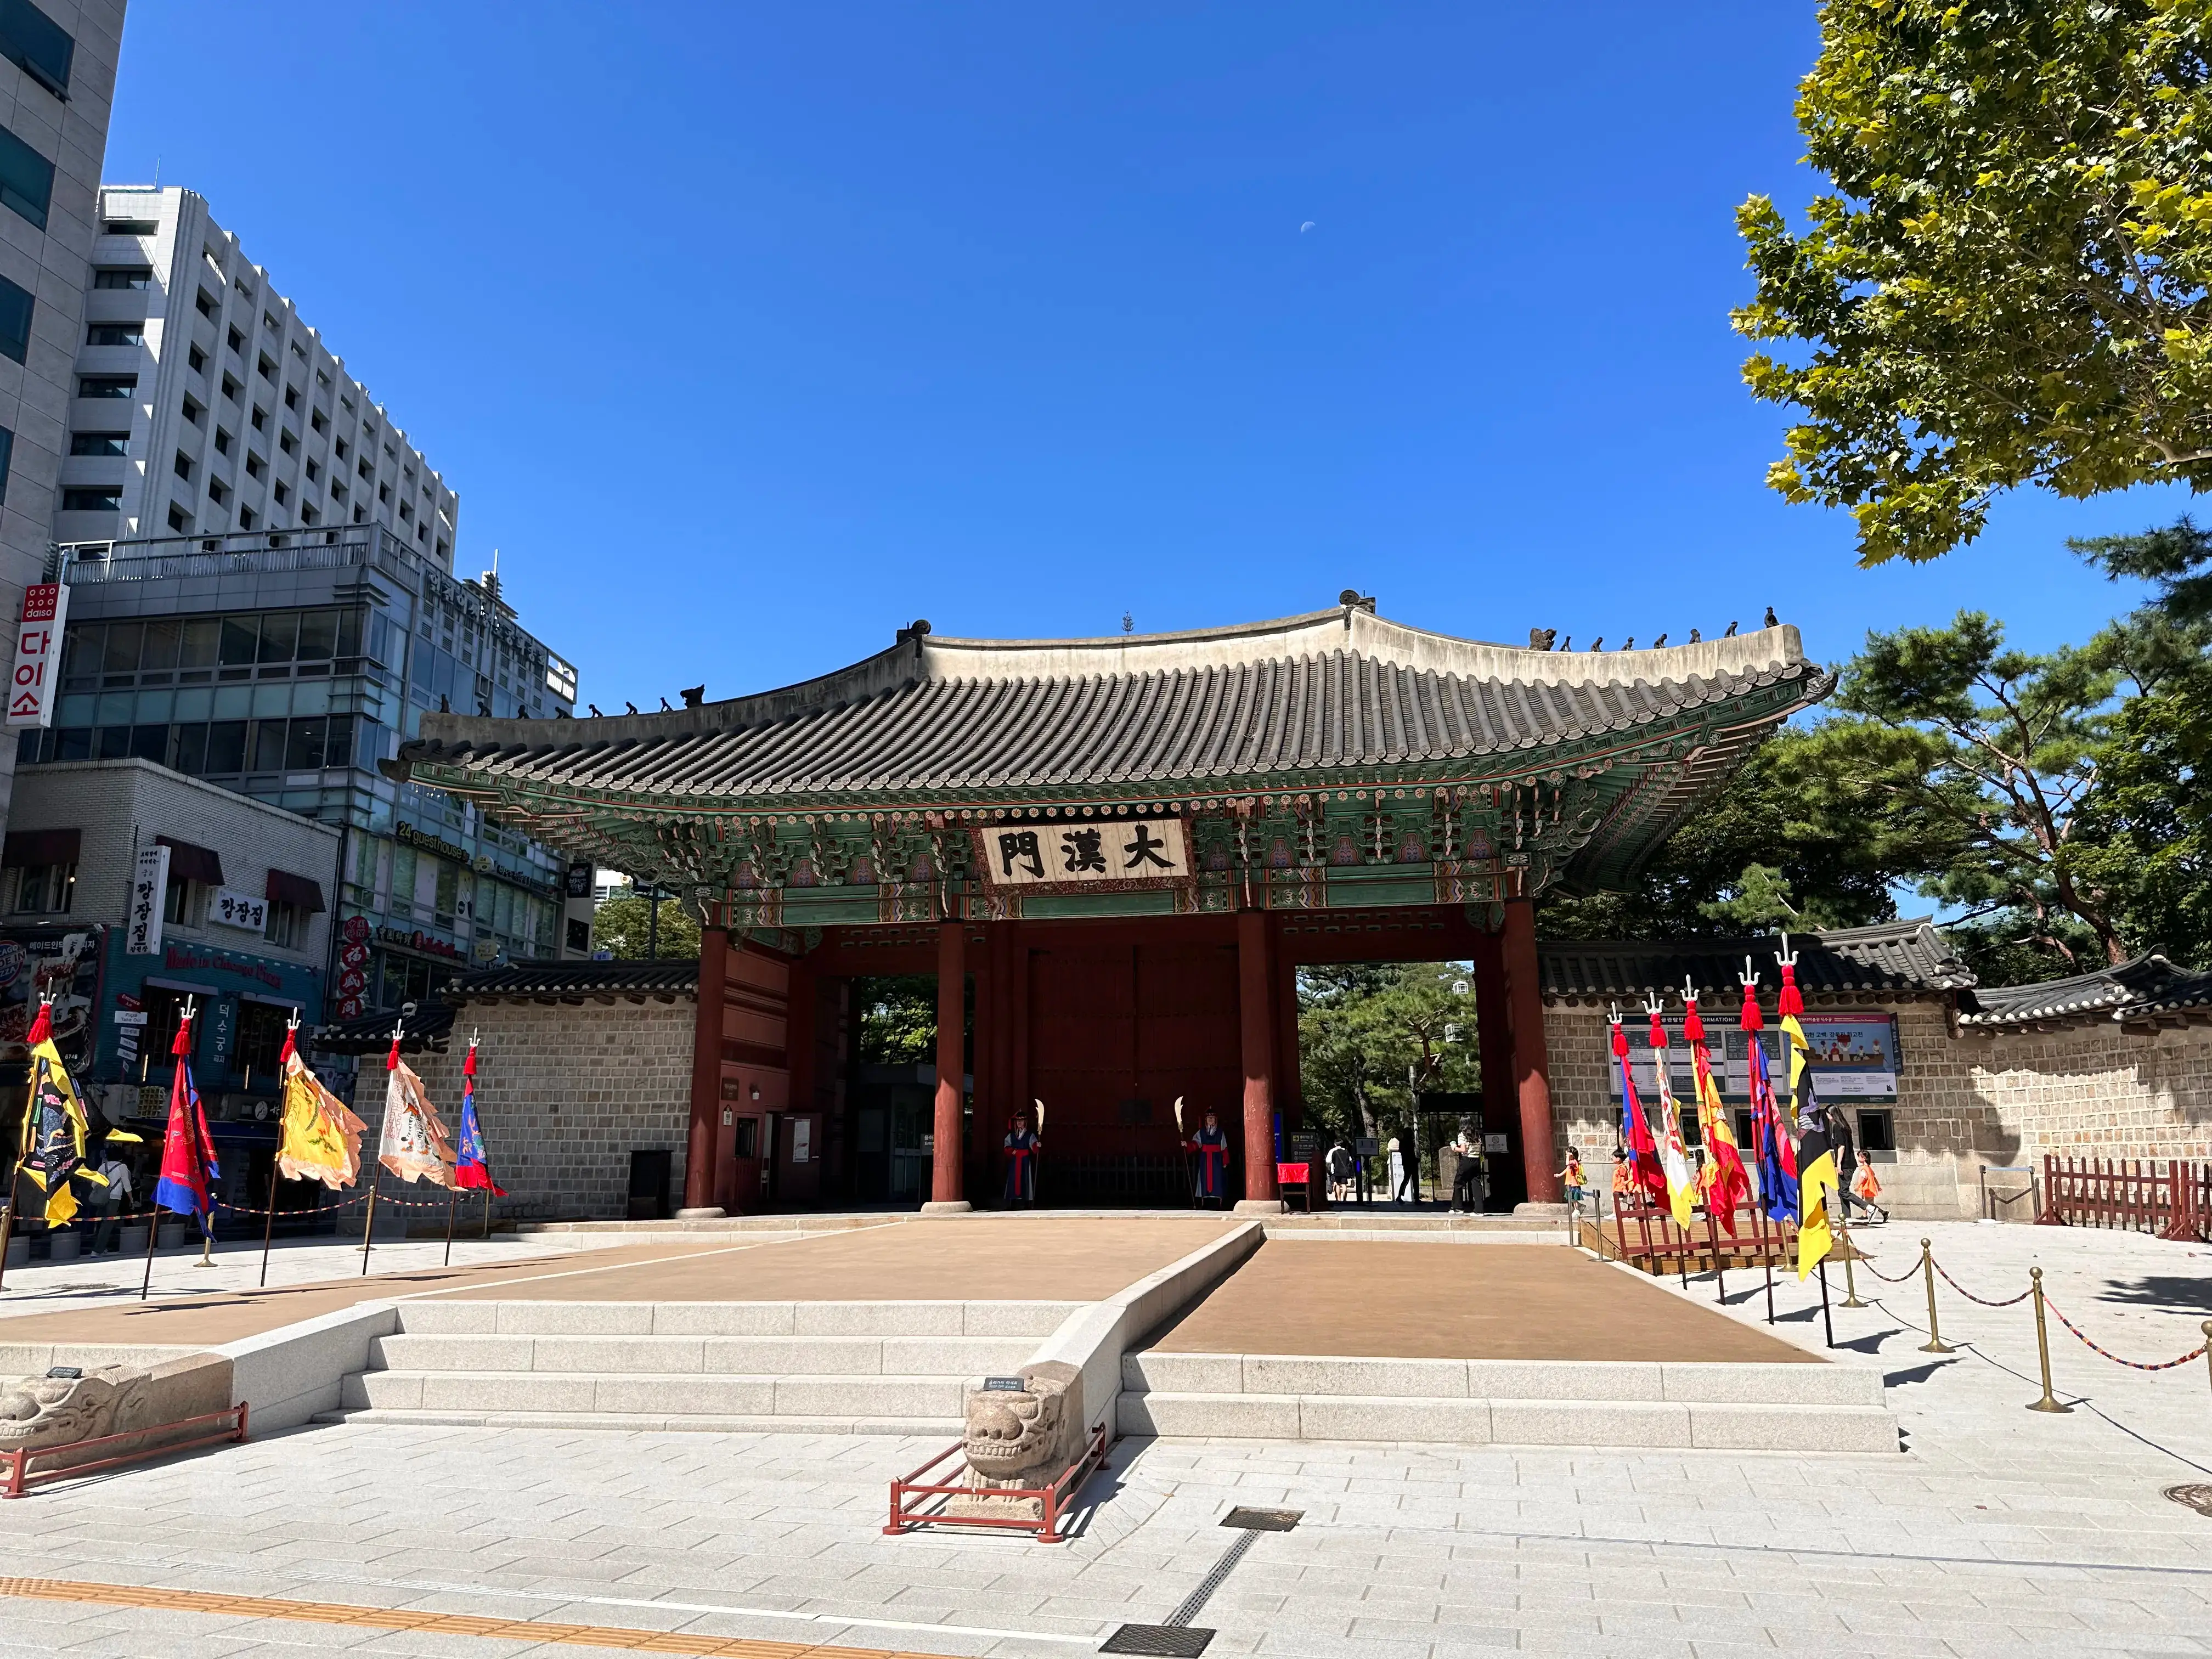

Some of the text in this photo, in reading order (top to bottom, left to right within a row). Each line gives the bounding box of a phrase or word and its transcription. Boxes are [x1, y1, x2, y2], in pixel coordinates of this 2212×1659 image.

[26, 609, 52, 618] daiso
[10, 631, 50, 716] 다이소
[399, 823, 411, 839] 24
[413, 831, 462, 859] guesthouse
[998, 825, 1176, 878] 大漢門
[132, 881, 154, 942] 깡장집
[221, 898, 263, 926] 깡장집
[15, 951, 25, 962] IN
[30, 941, 63, 950] 메이드인
[165, 947, 281, 989] Made in Chicago Pizza
[121, 994, 140, 1006] Entrance
[216, 1004, 229, 1051] 덕수궁
